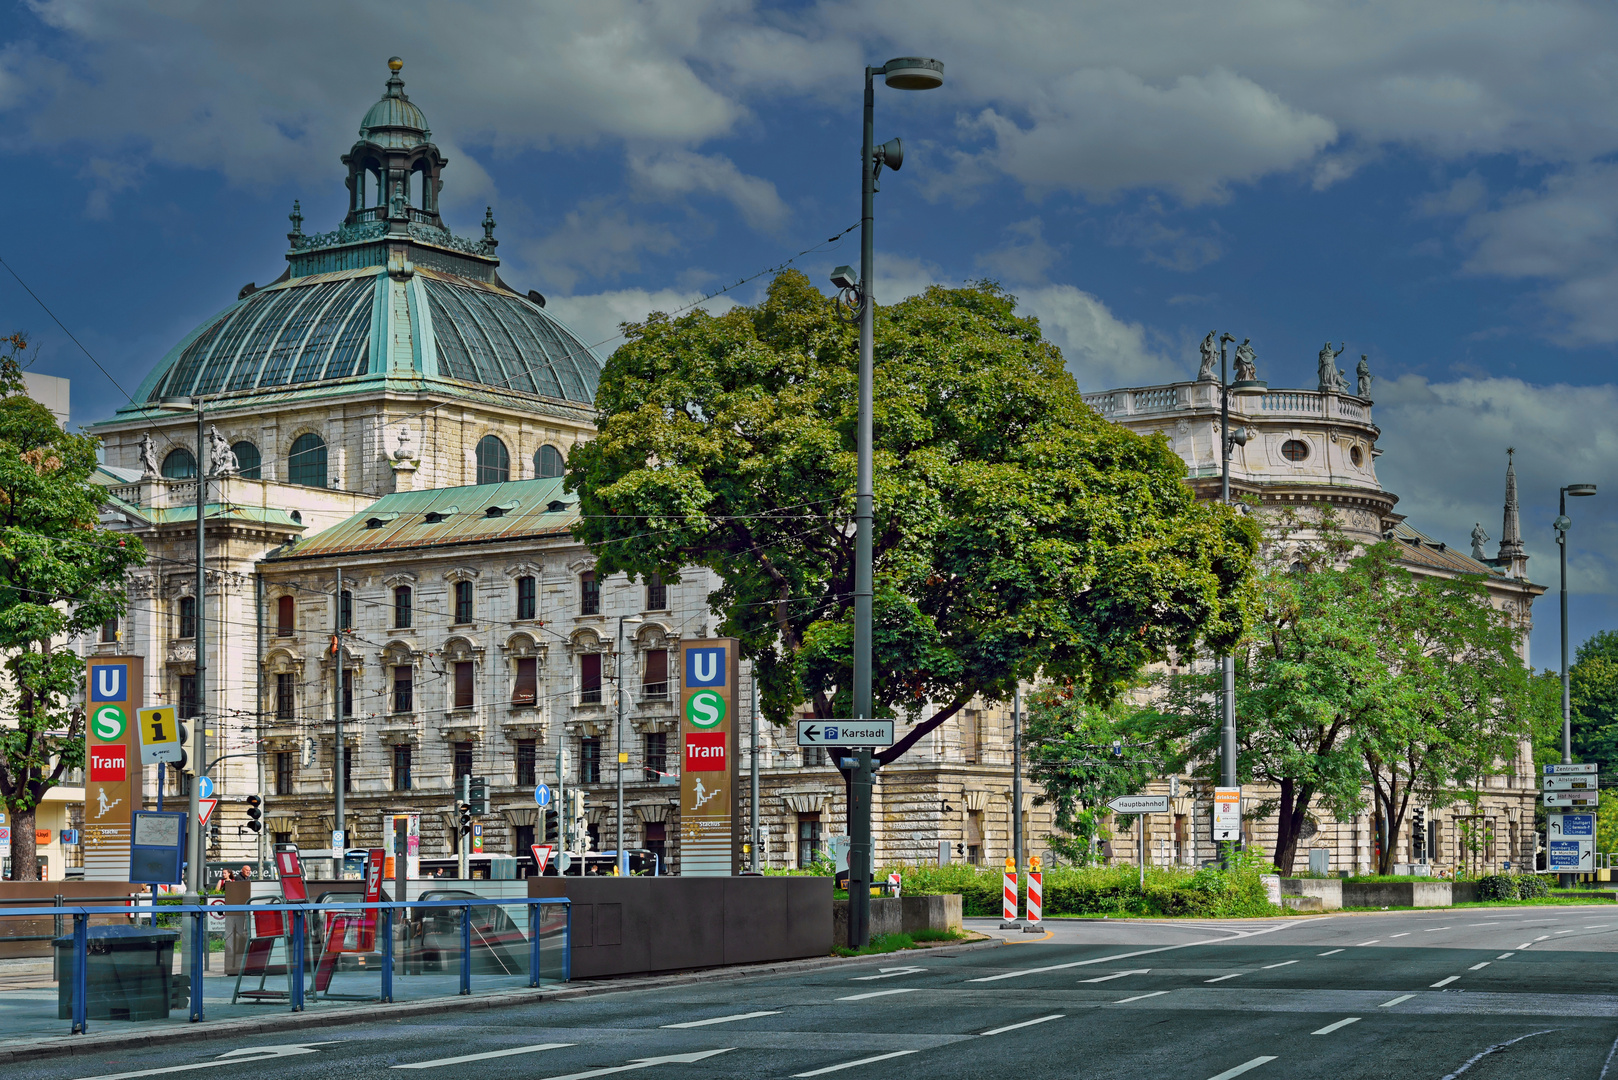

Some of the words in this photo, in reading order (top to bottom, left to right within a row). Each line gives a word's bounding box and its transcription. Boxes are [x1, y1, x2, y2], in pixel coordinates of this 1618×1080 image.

[694, 652, 716, 682] U
[99, 669, 120, 697] U
[692, 693, 718, 725] S
[98, 708, 121, 738] S
[842, 728, 884, 738] Karstadt
[686, 744, 724, 758] Tram
[92, 756, 125, 769] Tram
[475, 826, 481, 835] U
[475, 837, 481, 847] S
